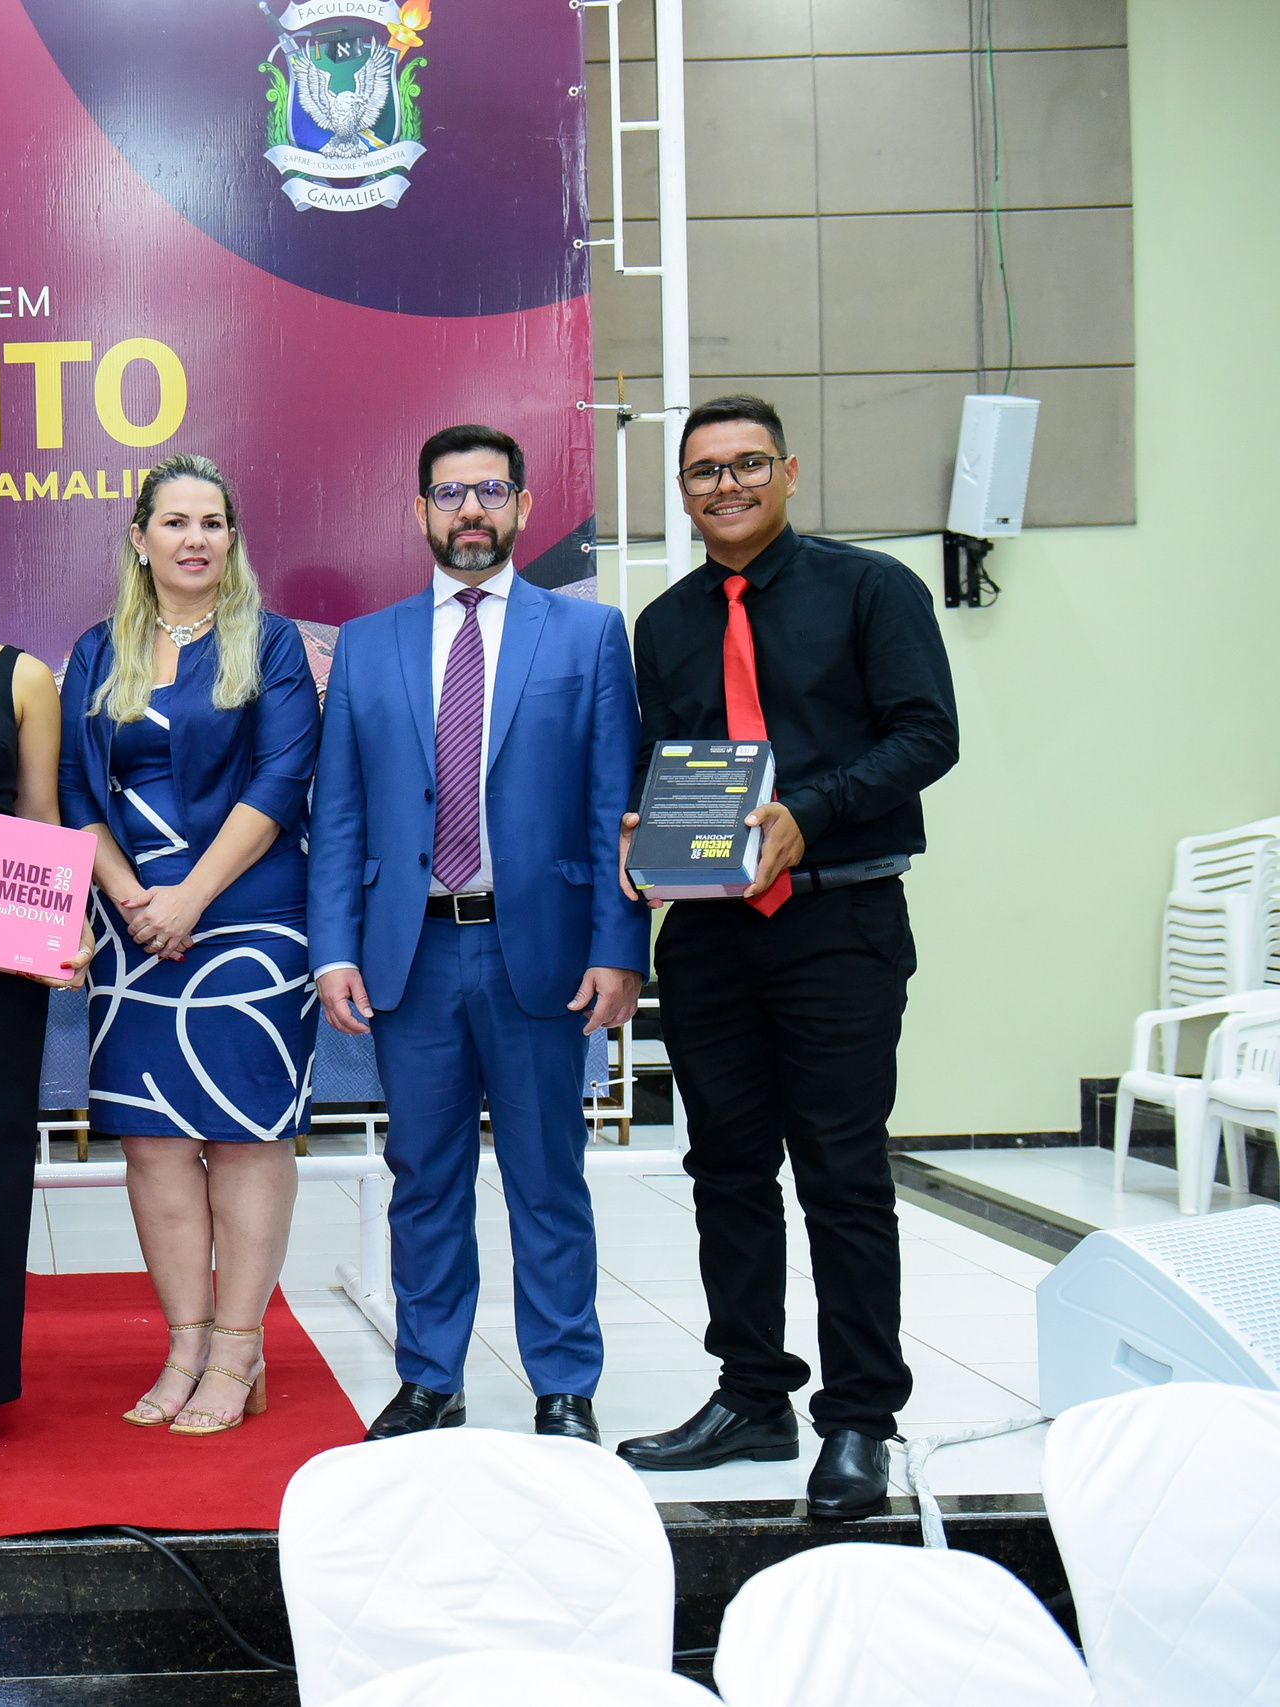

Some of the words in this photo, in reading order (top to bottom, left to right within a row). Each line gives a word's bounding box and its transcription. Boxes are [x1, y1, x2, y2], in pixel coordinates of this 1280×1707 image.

[297, 2, 385, 20] FACULDADE
[283, 155, 312, 166] SAPERE
[363, 150, 406, 169] PRUDENTIA
[307, 187, 386, 207] GAMALIEL
[690, 840, 733, 849] MECUM
[701, 849, 730, 858] VADE
[2, 858, 53, 887] VADE
[55, 865, 73, 880] 20
[53, 877, 71, 891] 25
